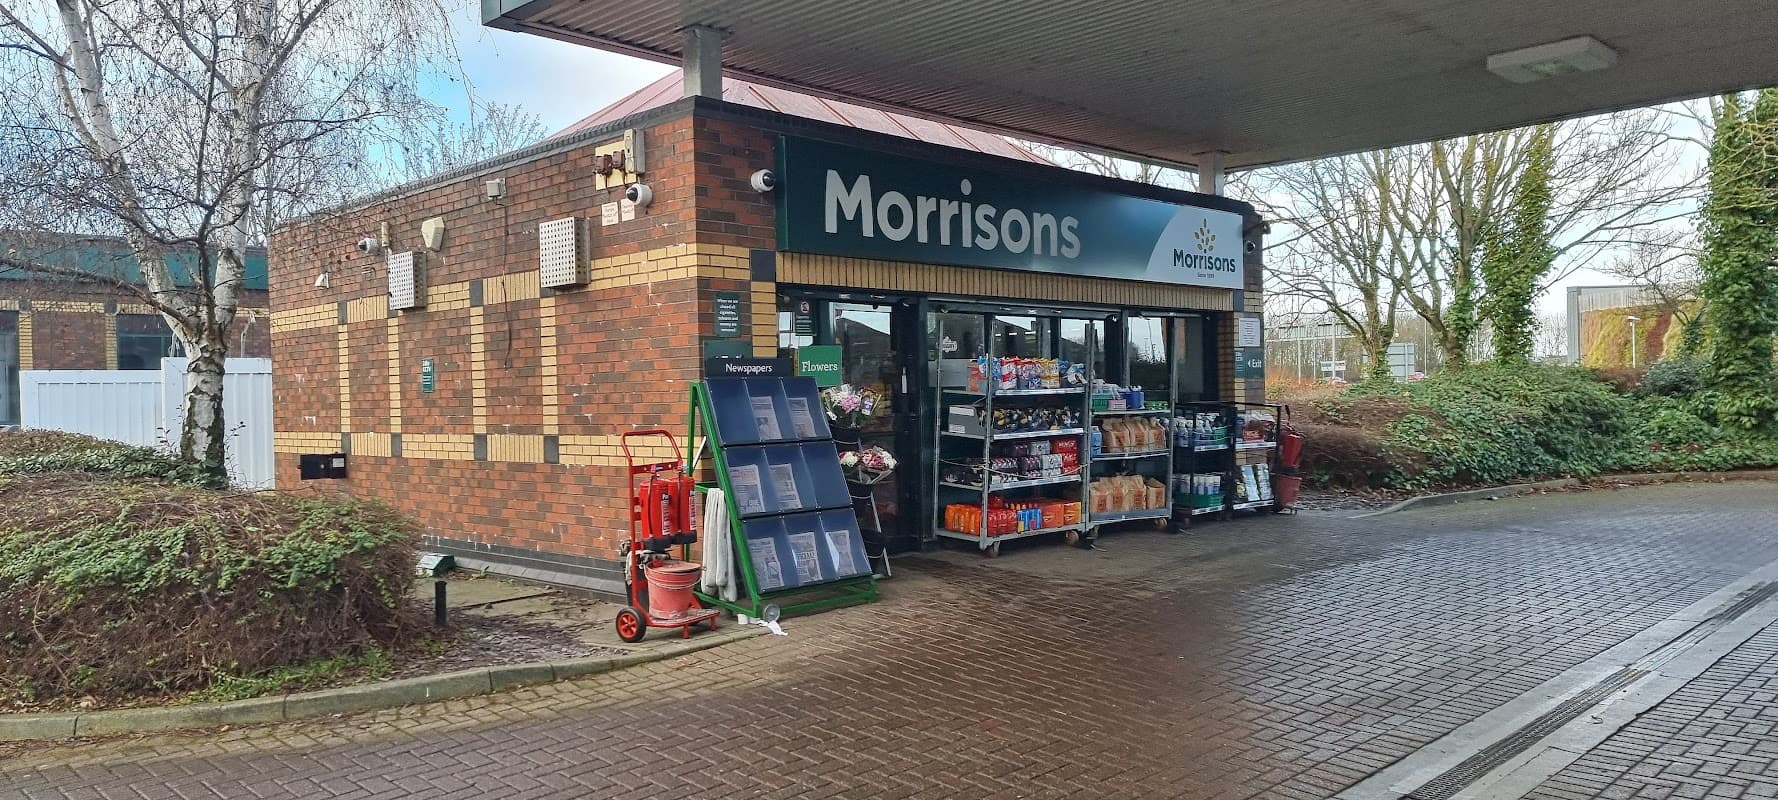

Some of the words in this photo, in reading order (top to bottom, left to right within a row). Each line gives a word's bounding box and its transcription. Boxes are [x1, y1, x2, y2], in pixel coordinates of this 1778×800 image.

[825, 169, 1080, 259] Morrisons
[1173, 248, 1236, 273] Morrisons
[725, 363, 773, 376] Newspapers
[801, 361, 838, 372] Flowers
[1252, 359, 1262, 368] Exit
